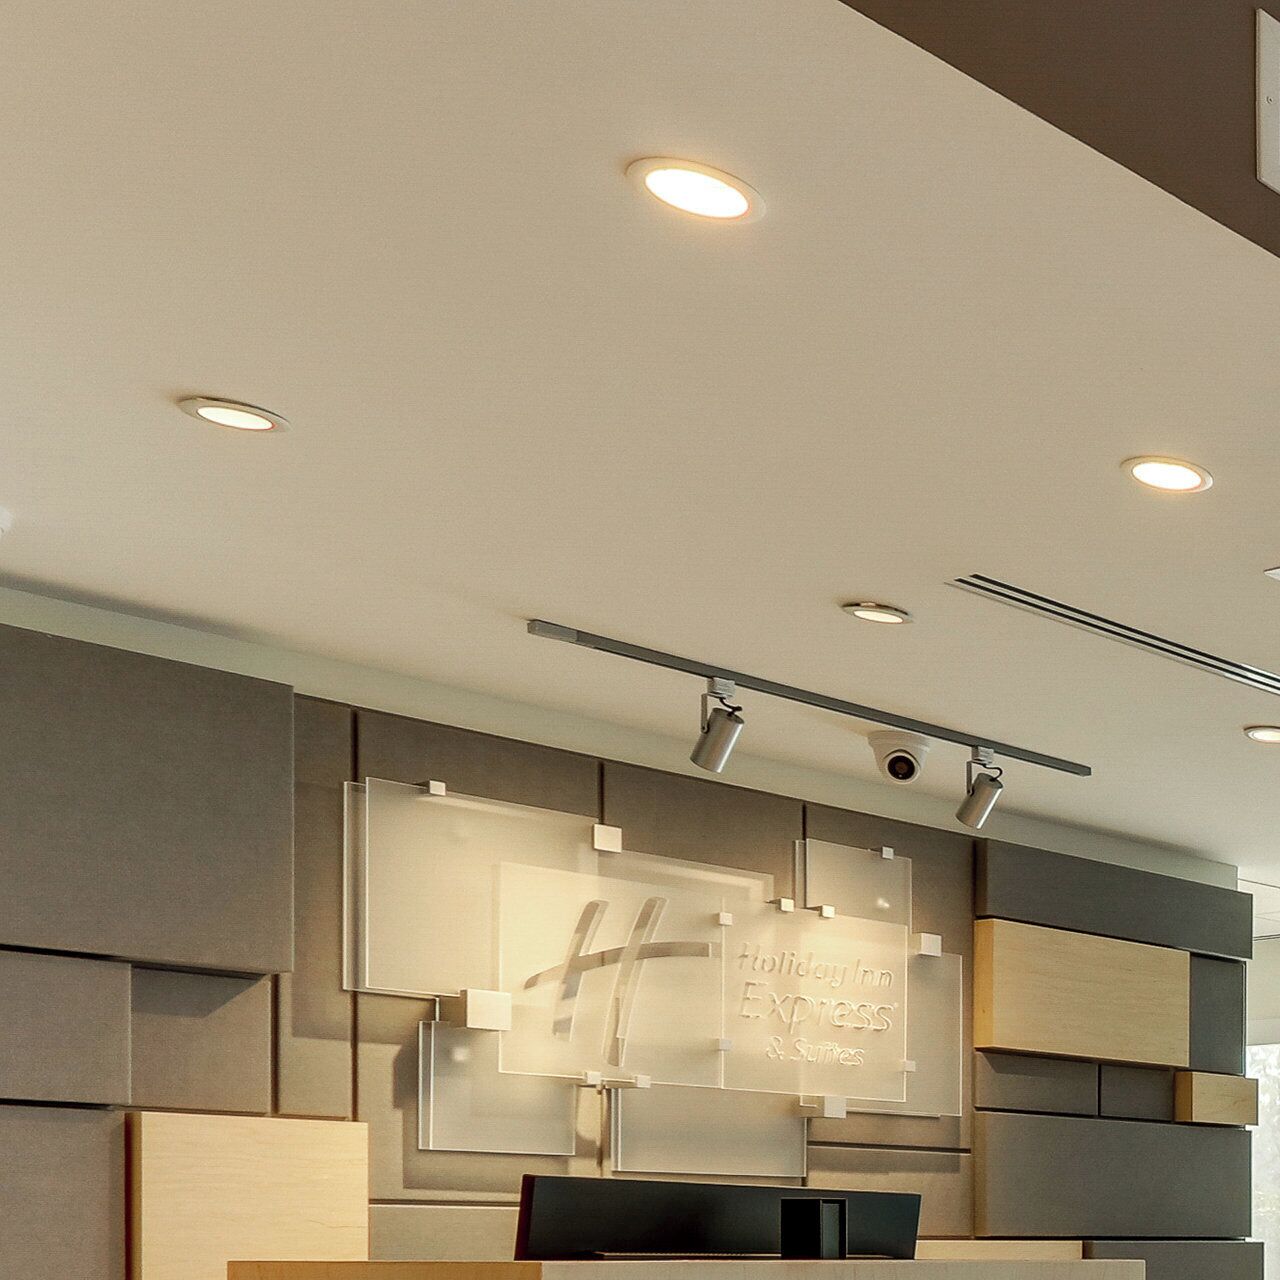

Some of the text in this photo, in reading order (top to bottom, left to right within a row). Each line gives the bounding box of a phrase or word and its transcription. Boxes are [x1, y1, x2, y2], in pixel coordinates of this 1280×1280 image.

[738, 942, 893, 988] Holiday Inn
[739, 981, 894, 1034] Express
[766, 1036, 865, 1066] & Suites
